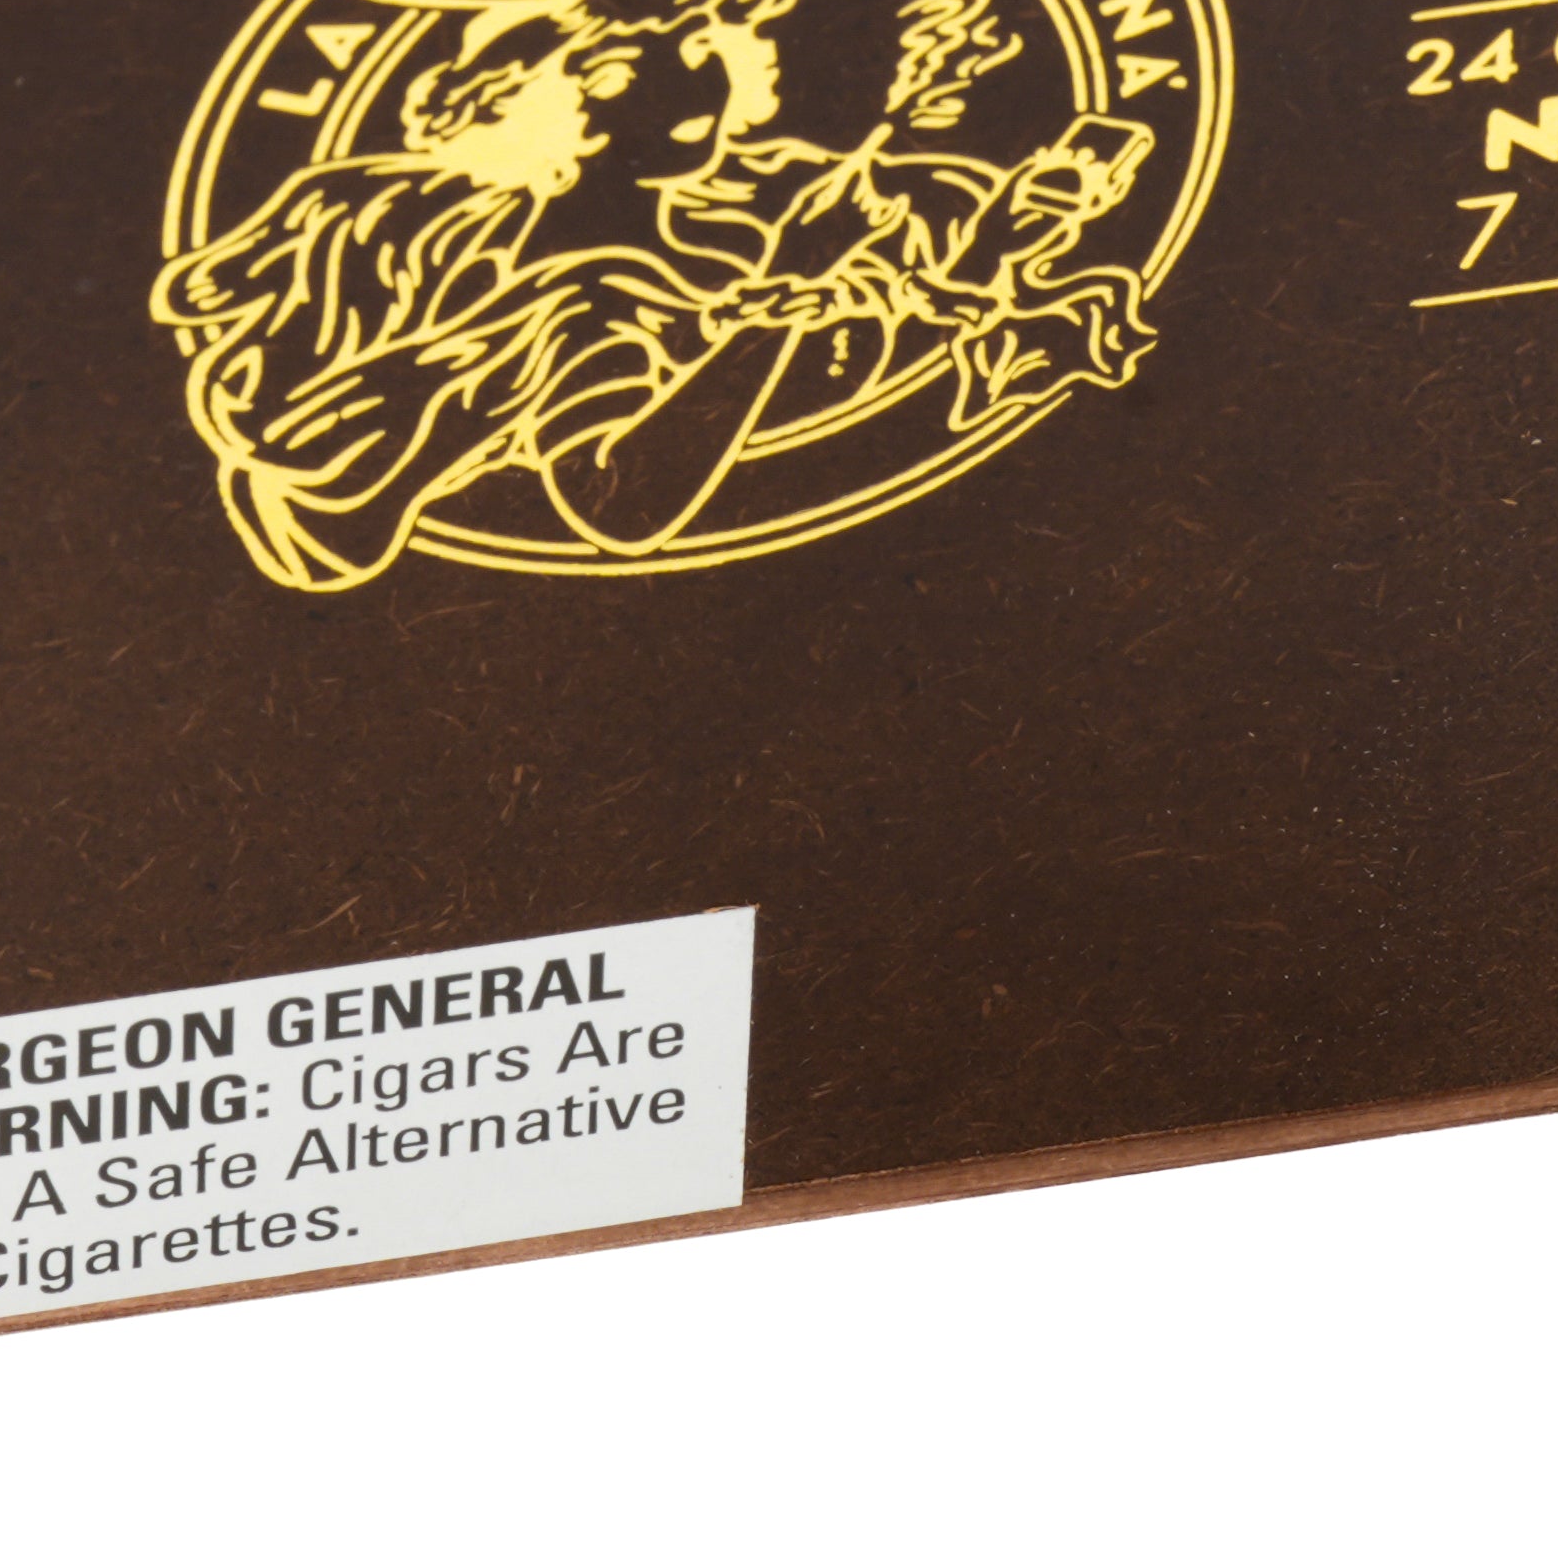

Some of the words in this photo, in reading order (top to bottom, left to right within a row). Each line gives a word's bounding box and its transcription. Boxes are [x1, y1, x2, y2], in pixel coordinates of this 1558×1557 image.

[258, 23, 375, 116] LA
[1405, 28, 1519, 96] 24
[1456, 191, 1519, 270] 7
[267, 952, 625, 1050] GENERAL
[302, 1045, 530, 1113] Cigars
[556, 1020, 685, 1074] Are
[12, 1169, 67, 1222] A
[95, 1143, 258, 1209] Safe
[285, 1086, 685, 1181] Alternative
